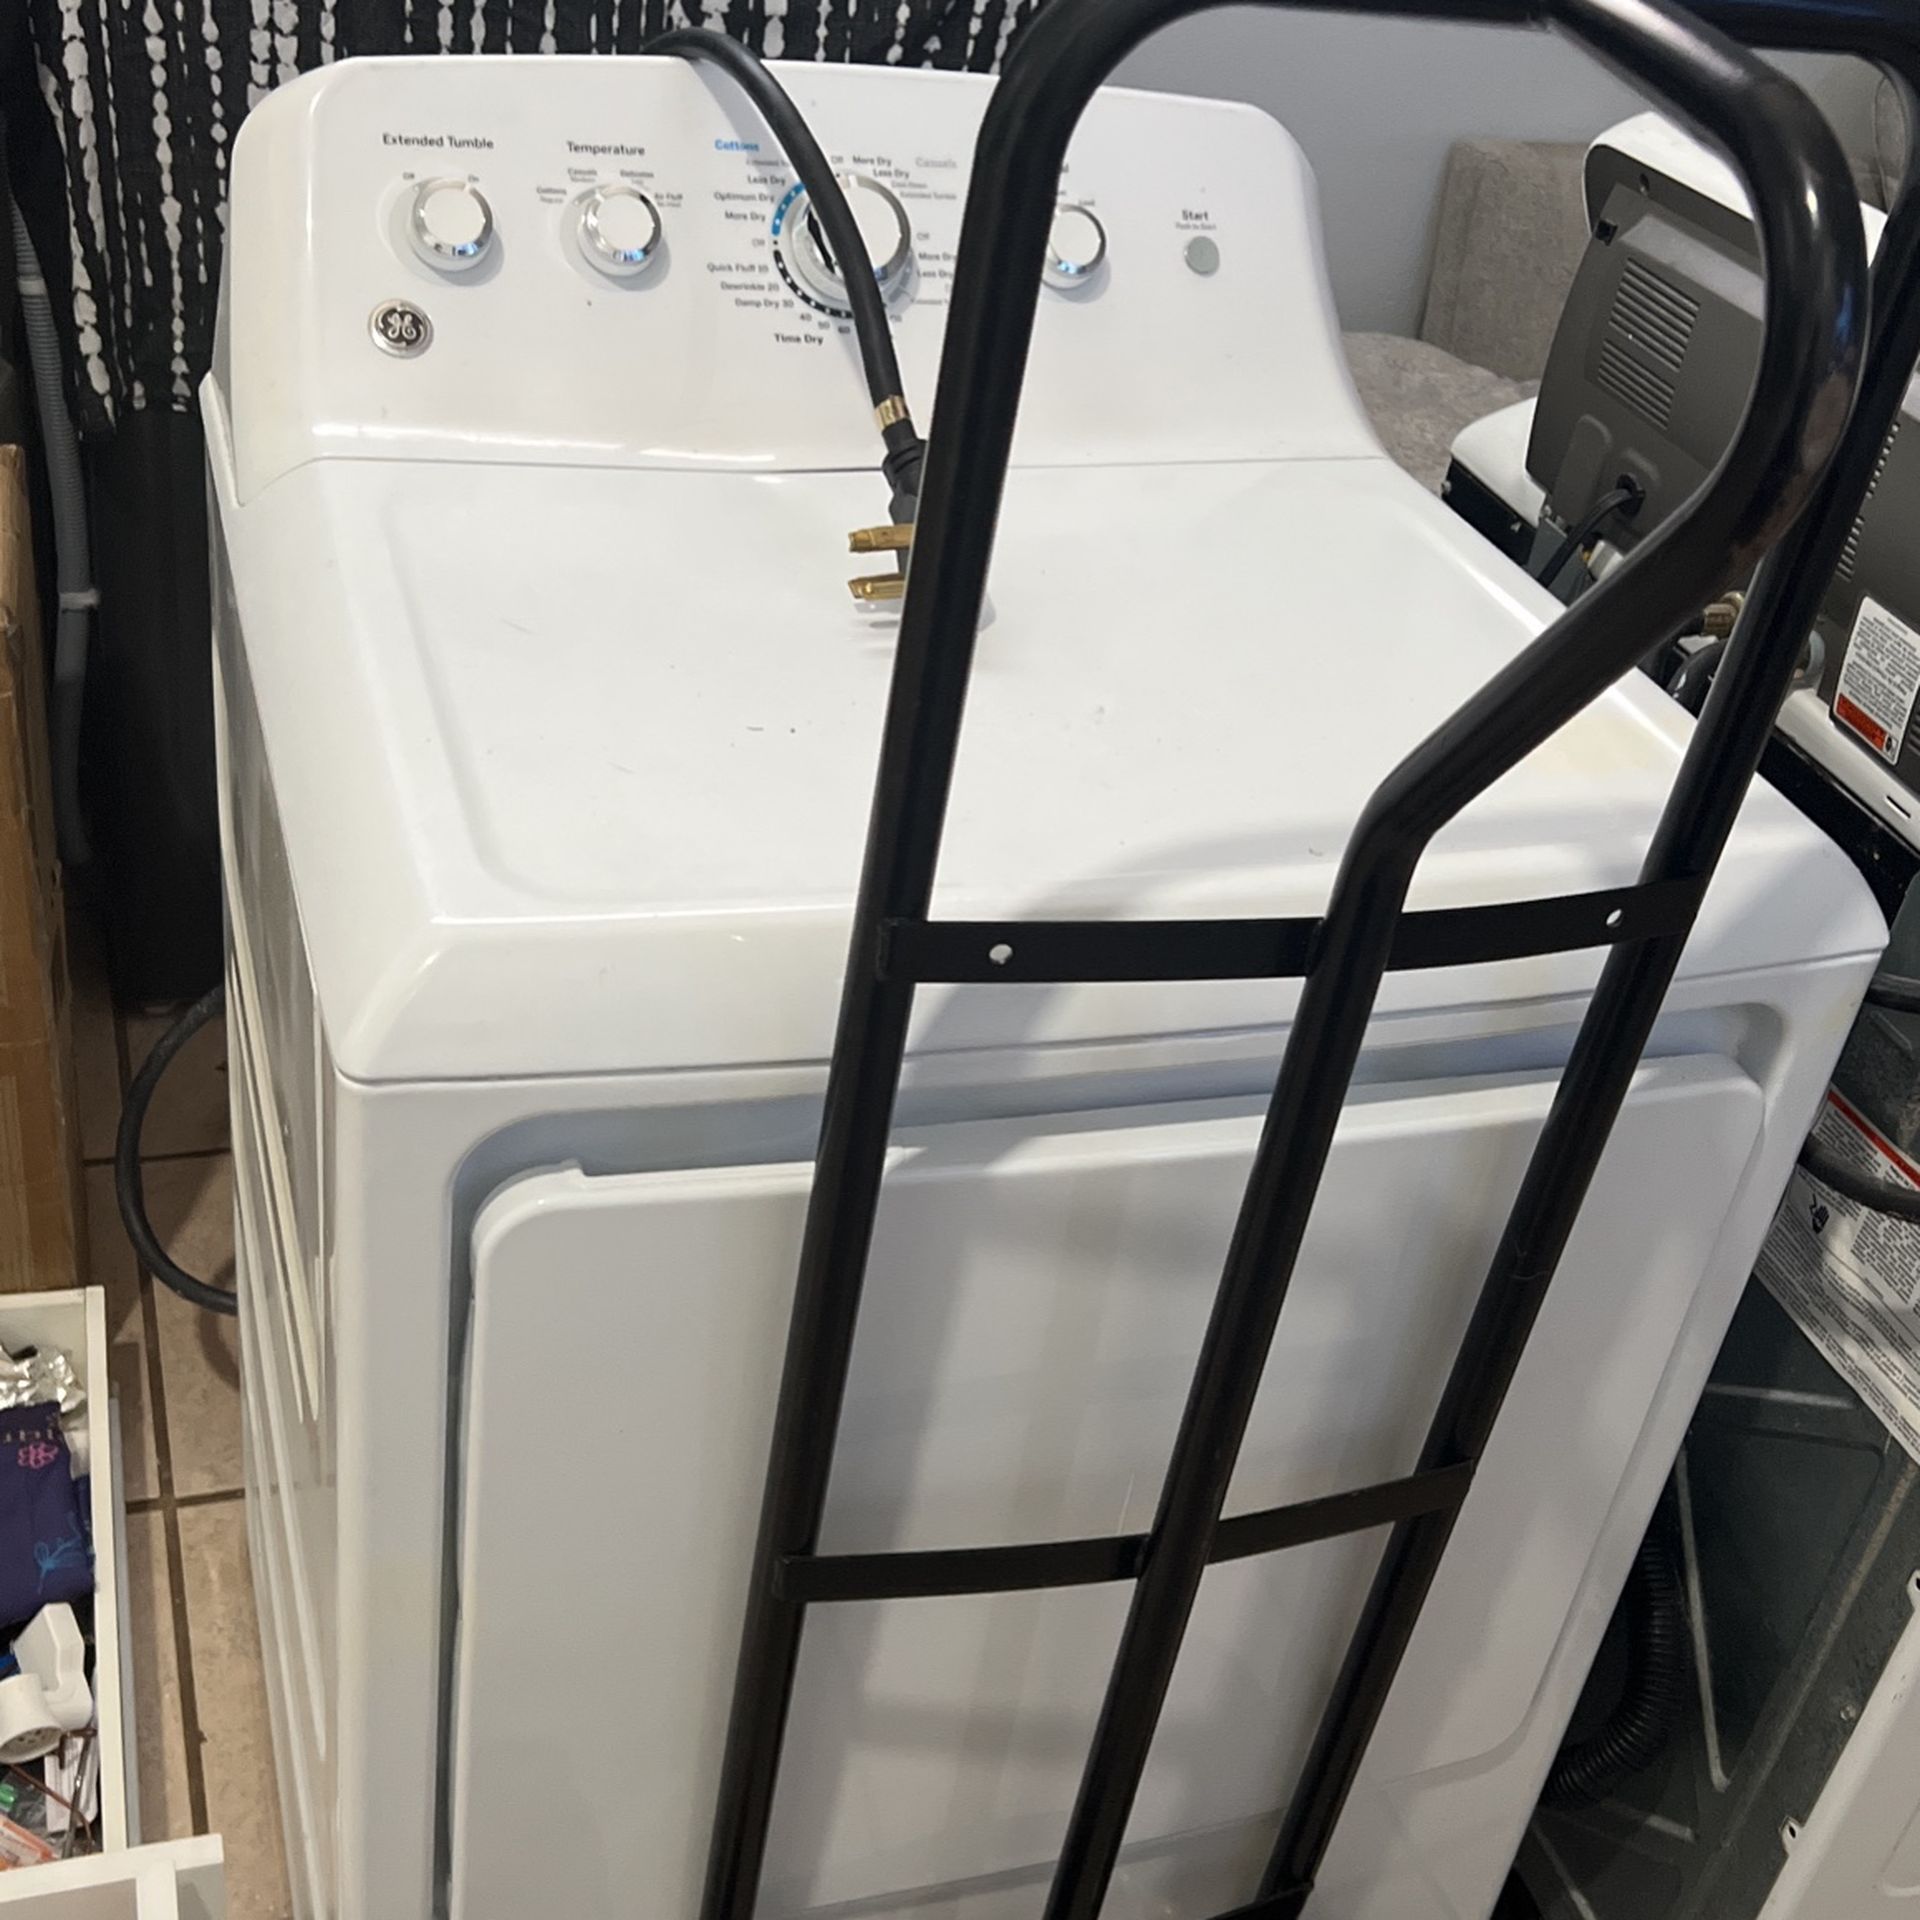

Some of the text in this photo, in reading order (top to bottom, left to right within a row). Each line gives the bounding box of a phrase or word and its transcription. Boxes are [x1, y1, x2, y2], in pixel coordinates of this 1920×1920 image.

[382, 132, 494, 149] Extended Tumble
[714, 139, 759, 151] Cottons
[566, 140, 645, 155] Temperature
[852, 155, 892, 166] More Dry
[873, 169, 909, 179] Less Dry
[769, 175, 786, 186] Dry
[713, 191, 775, 203] Optimum Dry
[725, 211, 766, 222] More Dry
[1182, 209, 1209, 221] Start
[707, 262, 733, 273] Quick
[735, 263, 755, 272] Fluff
[720, 281, 780, 291] Dewrinkle 20
[735, 298, 762, 308] Damp
[764, 299, 780, 308] Dry
[774, 333, 824, 345] Time Dry
